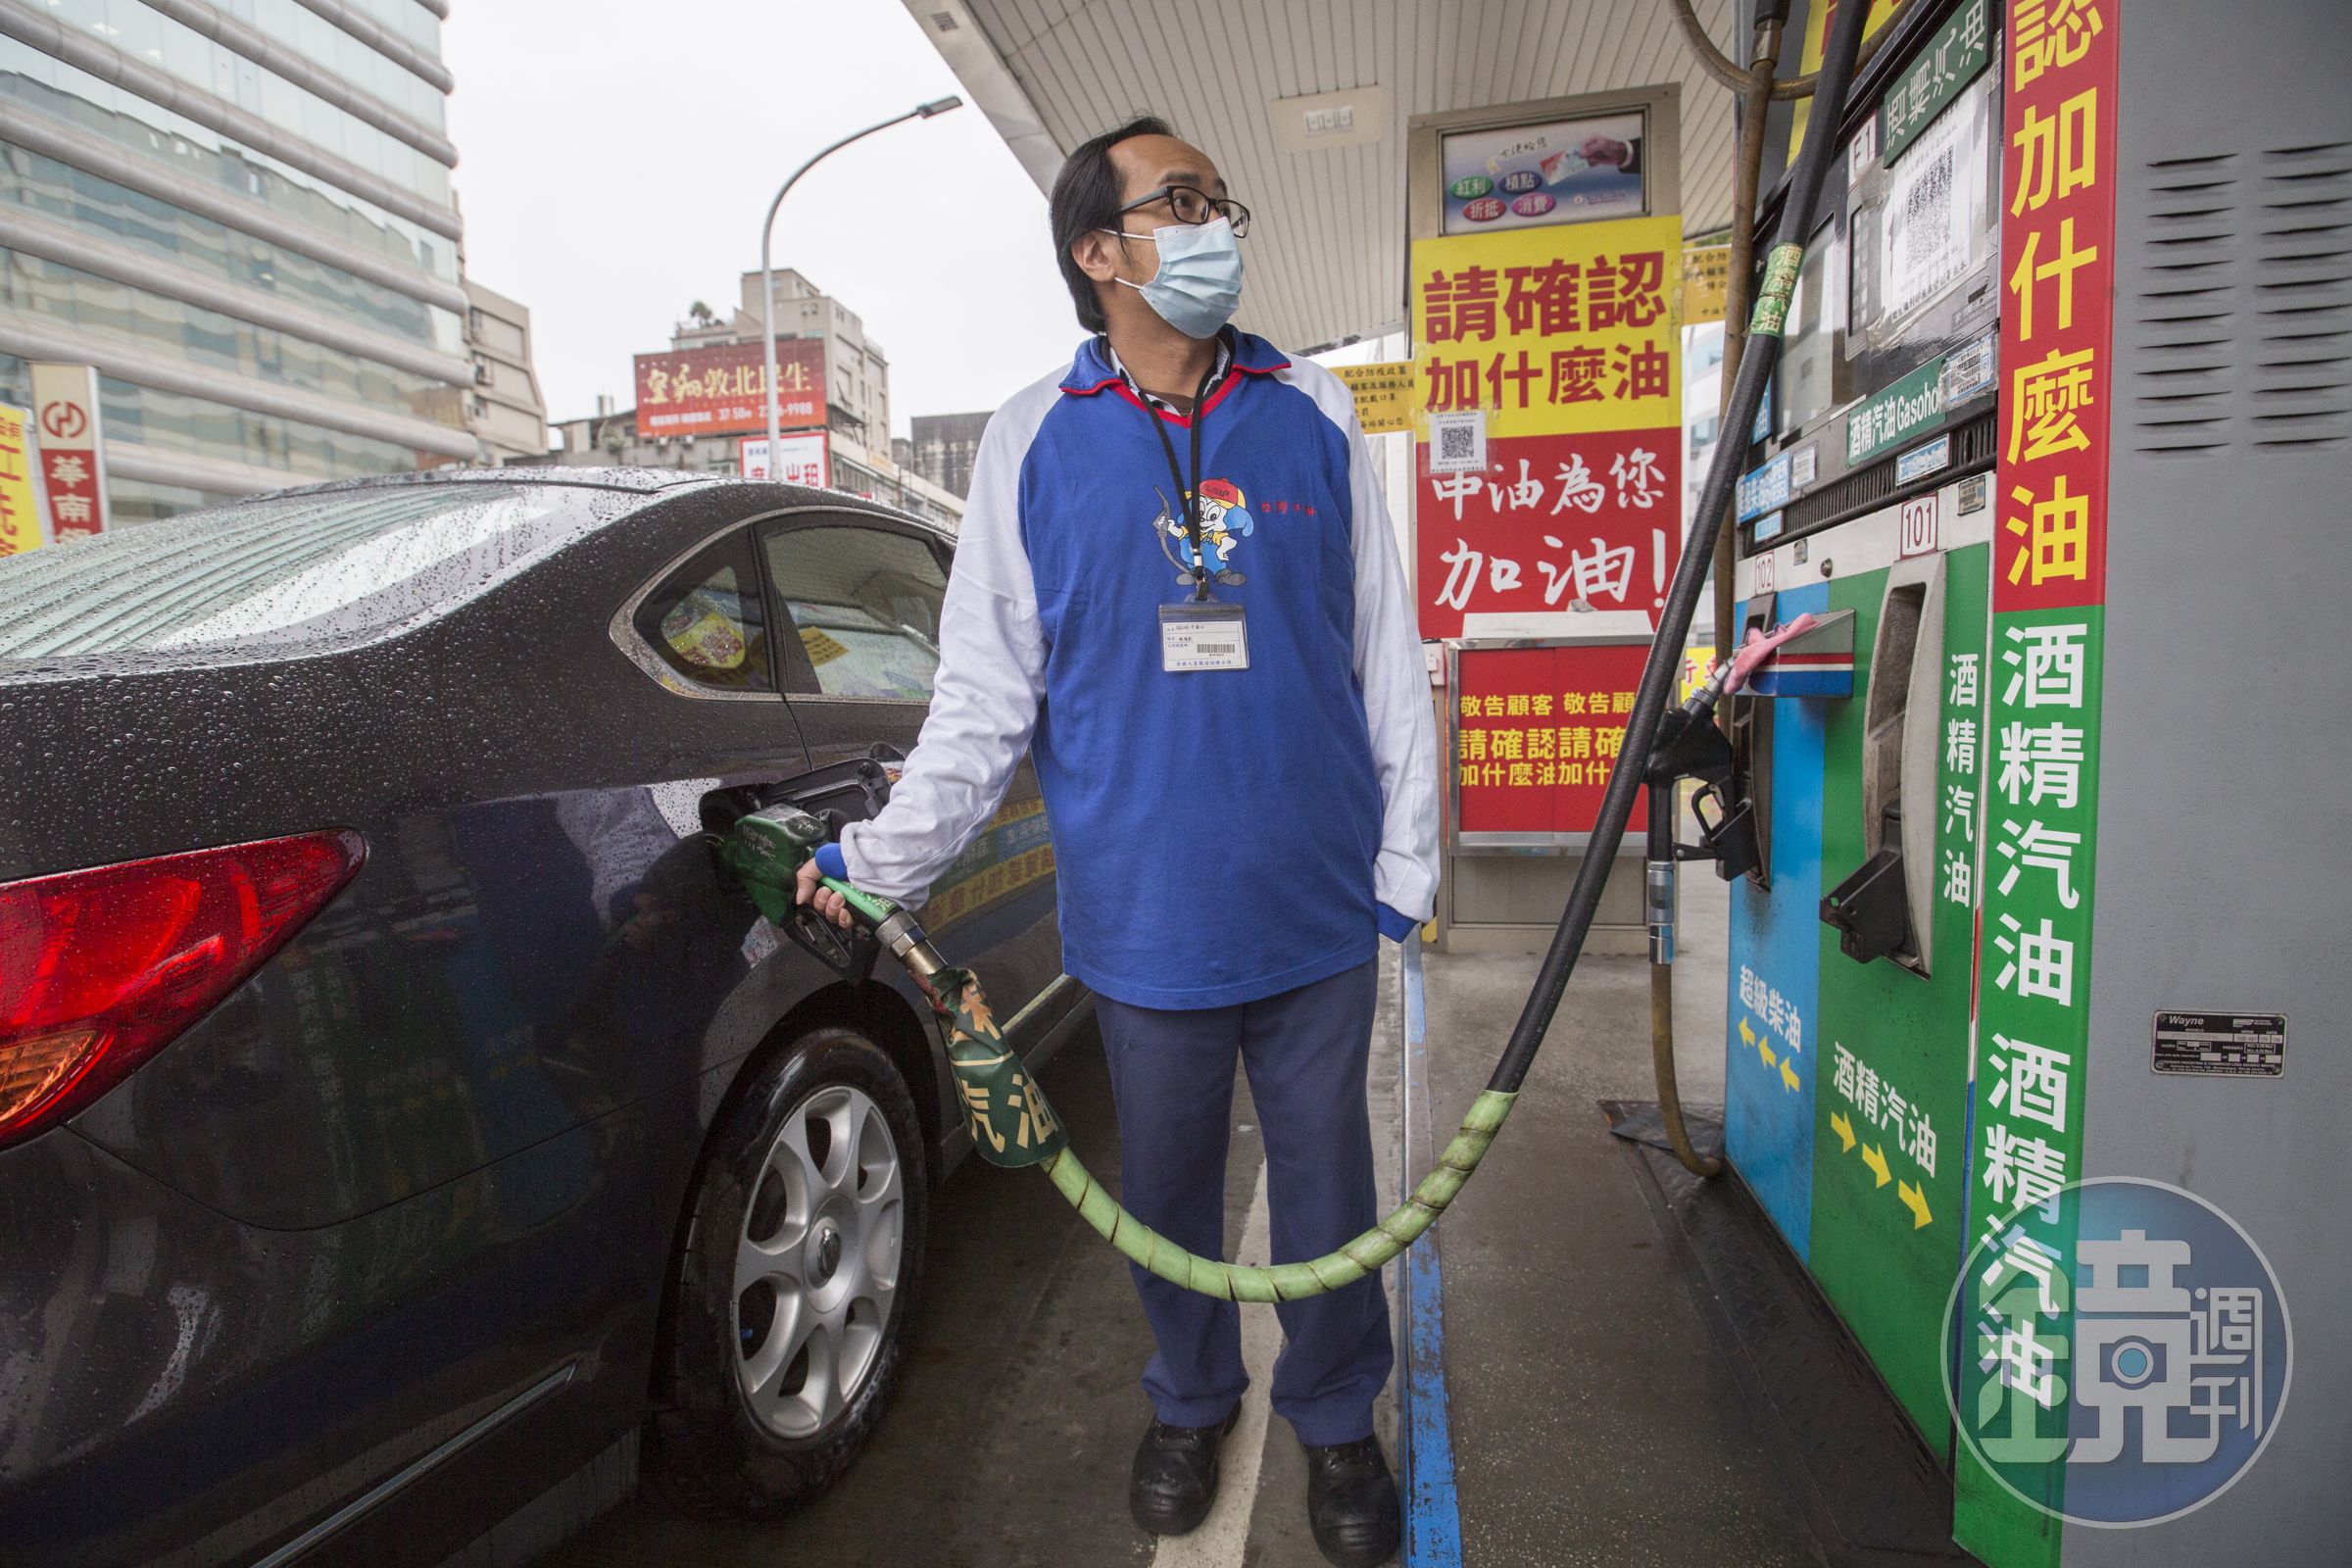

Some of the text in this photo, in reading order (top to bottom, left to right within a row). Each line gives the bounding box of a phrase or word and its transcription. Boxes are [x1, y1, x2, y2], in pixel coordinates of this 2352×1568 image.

[1457, 178, 1486, 194] 紅利
[1470, 201, 1499, 219] 折抵
[1505, 172, 1535, 190] 積點
[1518, 196, 1548, 213] 消費
[1422, 250, 1667, 345] 請確認
[1347, 379, 1415, 391] 顧客及服務人員
[1425, 339, 1670, 413] 加什麼油
[1848, 395, 1896, 460] 酒精汽油
[1431, 447, 1667, 520] 中油為您
[1906, 502, 1933, 549] 101
[1434, 527, 1668, 611] 加油!
[1755, 556, 1773, 590] 102
[1460, 694, 1553, 717] 敬告顧客
[1943, 653, 1980, 908] 酒精汽油
[1992, 622, 2089, 1008] 酒精汽油
[1739, 964, 1802, 1054] 超級柴油
[2169, 1015, 2205, 1027] Wayne
[1833, 1041, 1937, 1179] 酒精汽油
[1977, 1032, 2072, 1410] 酒精汽油
